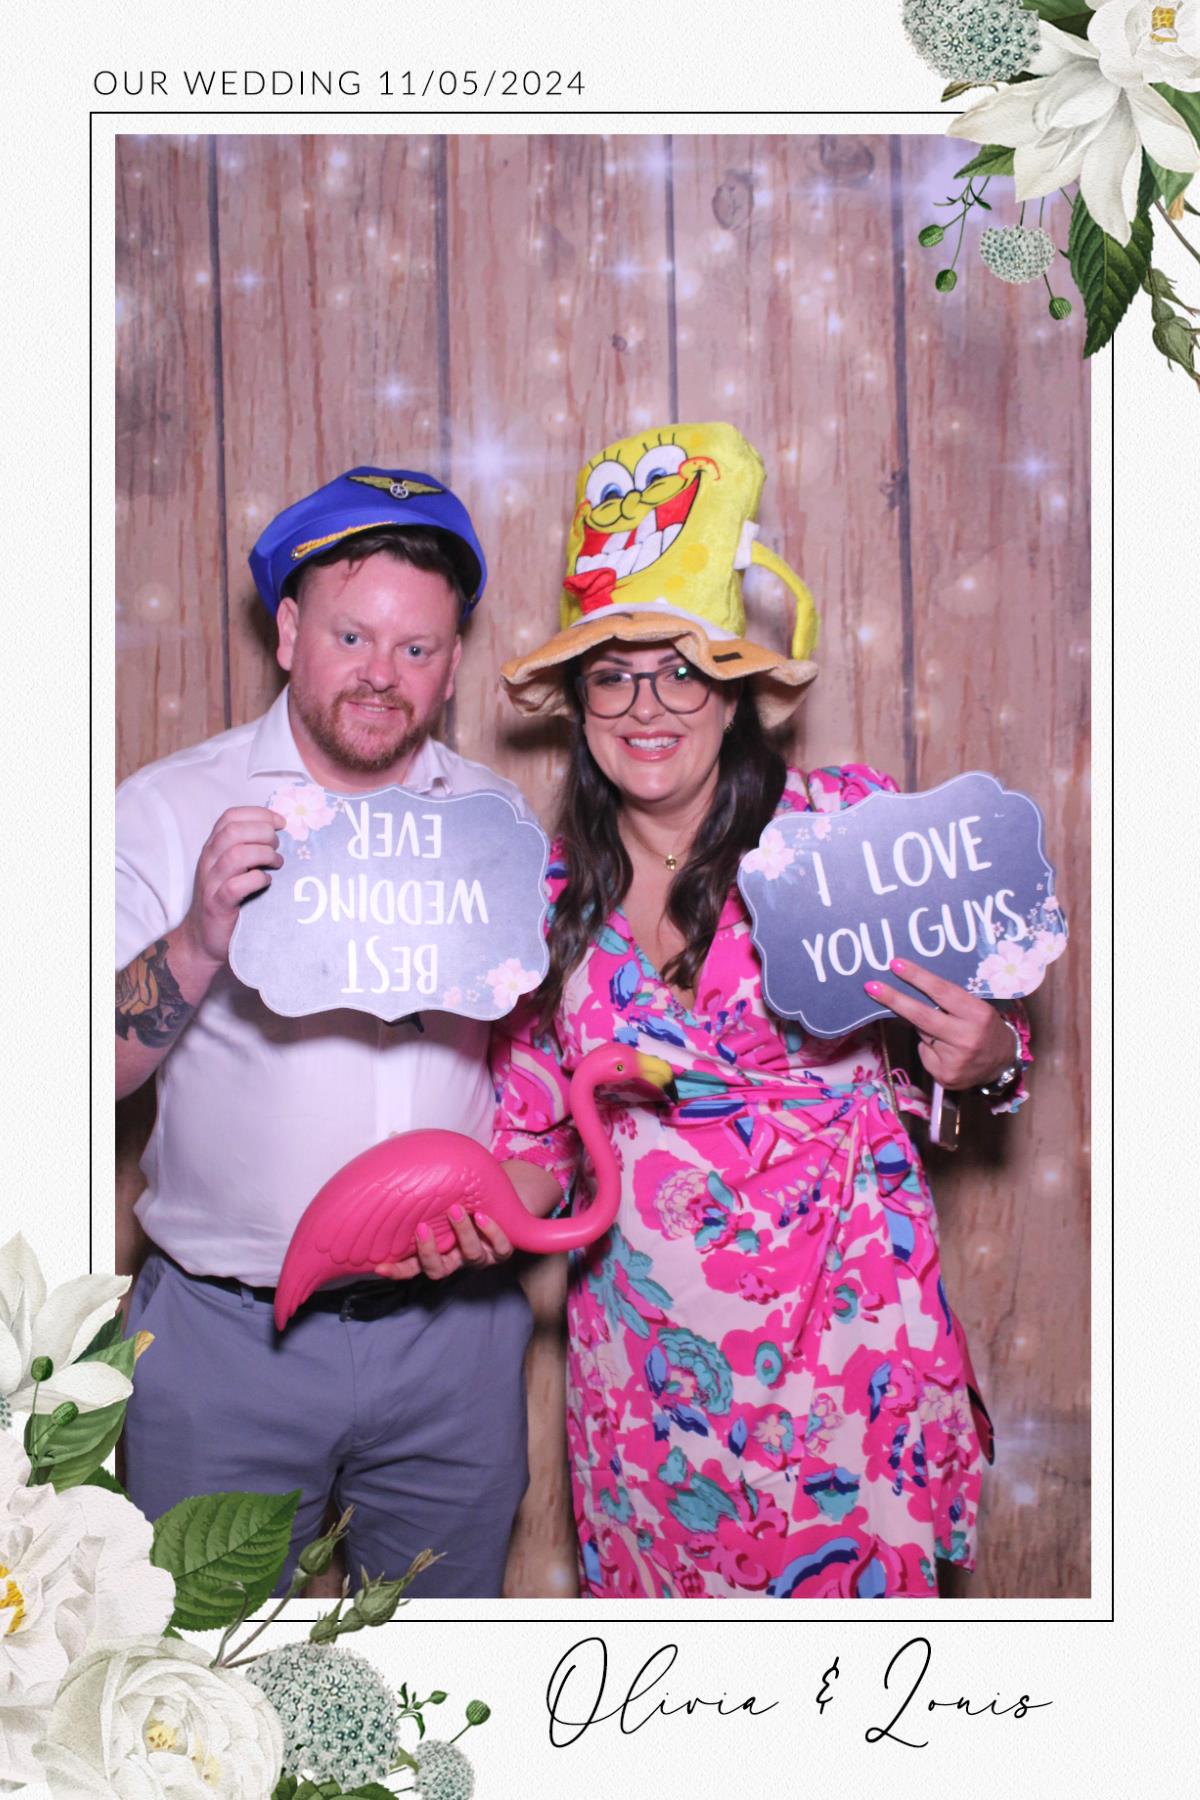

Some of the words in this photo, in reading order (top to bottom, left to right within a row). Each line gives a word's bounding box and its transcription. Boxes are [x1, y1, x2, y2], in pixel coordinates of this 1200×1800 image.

[345, 800, 443, 860] EVER
[811, 851, 833, 908] I
[862, 815, 993, 896] LOVE
[293, 873, 490, 926] WEDDING
[341, 935, 439, 995] BEST
[801, 918, 896, 984] YOU
[907, 889, 1028, 958] GUYS
